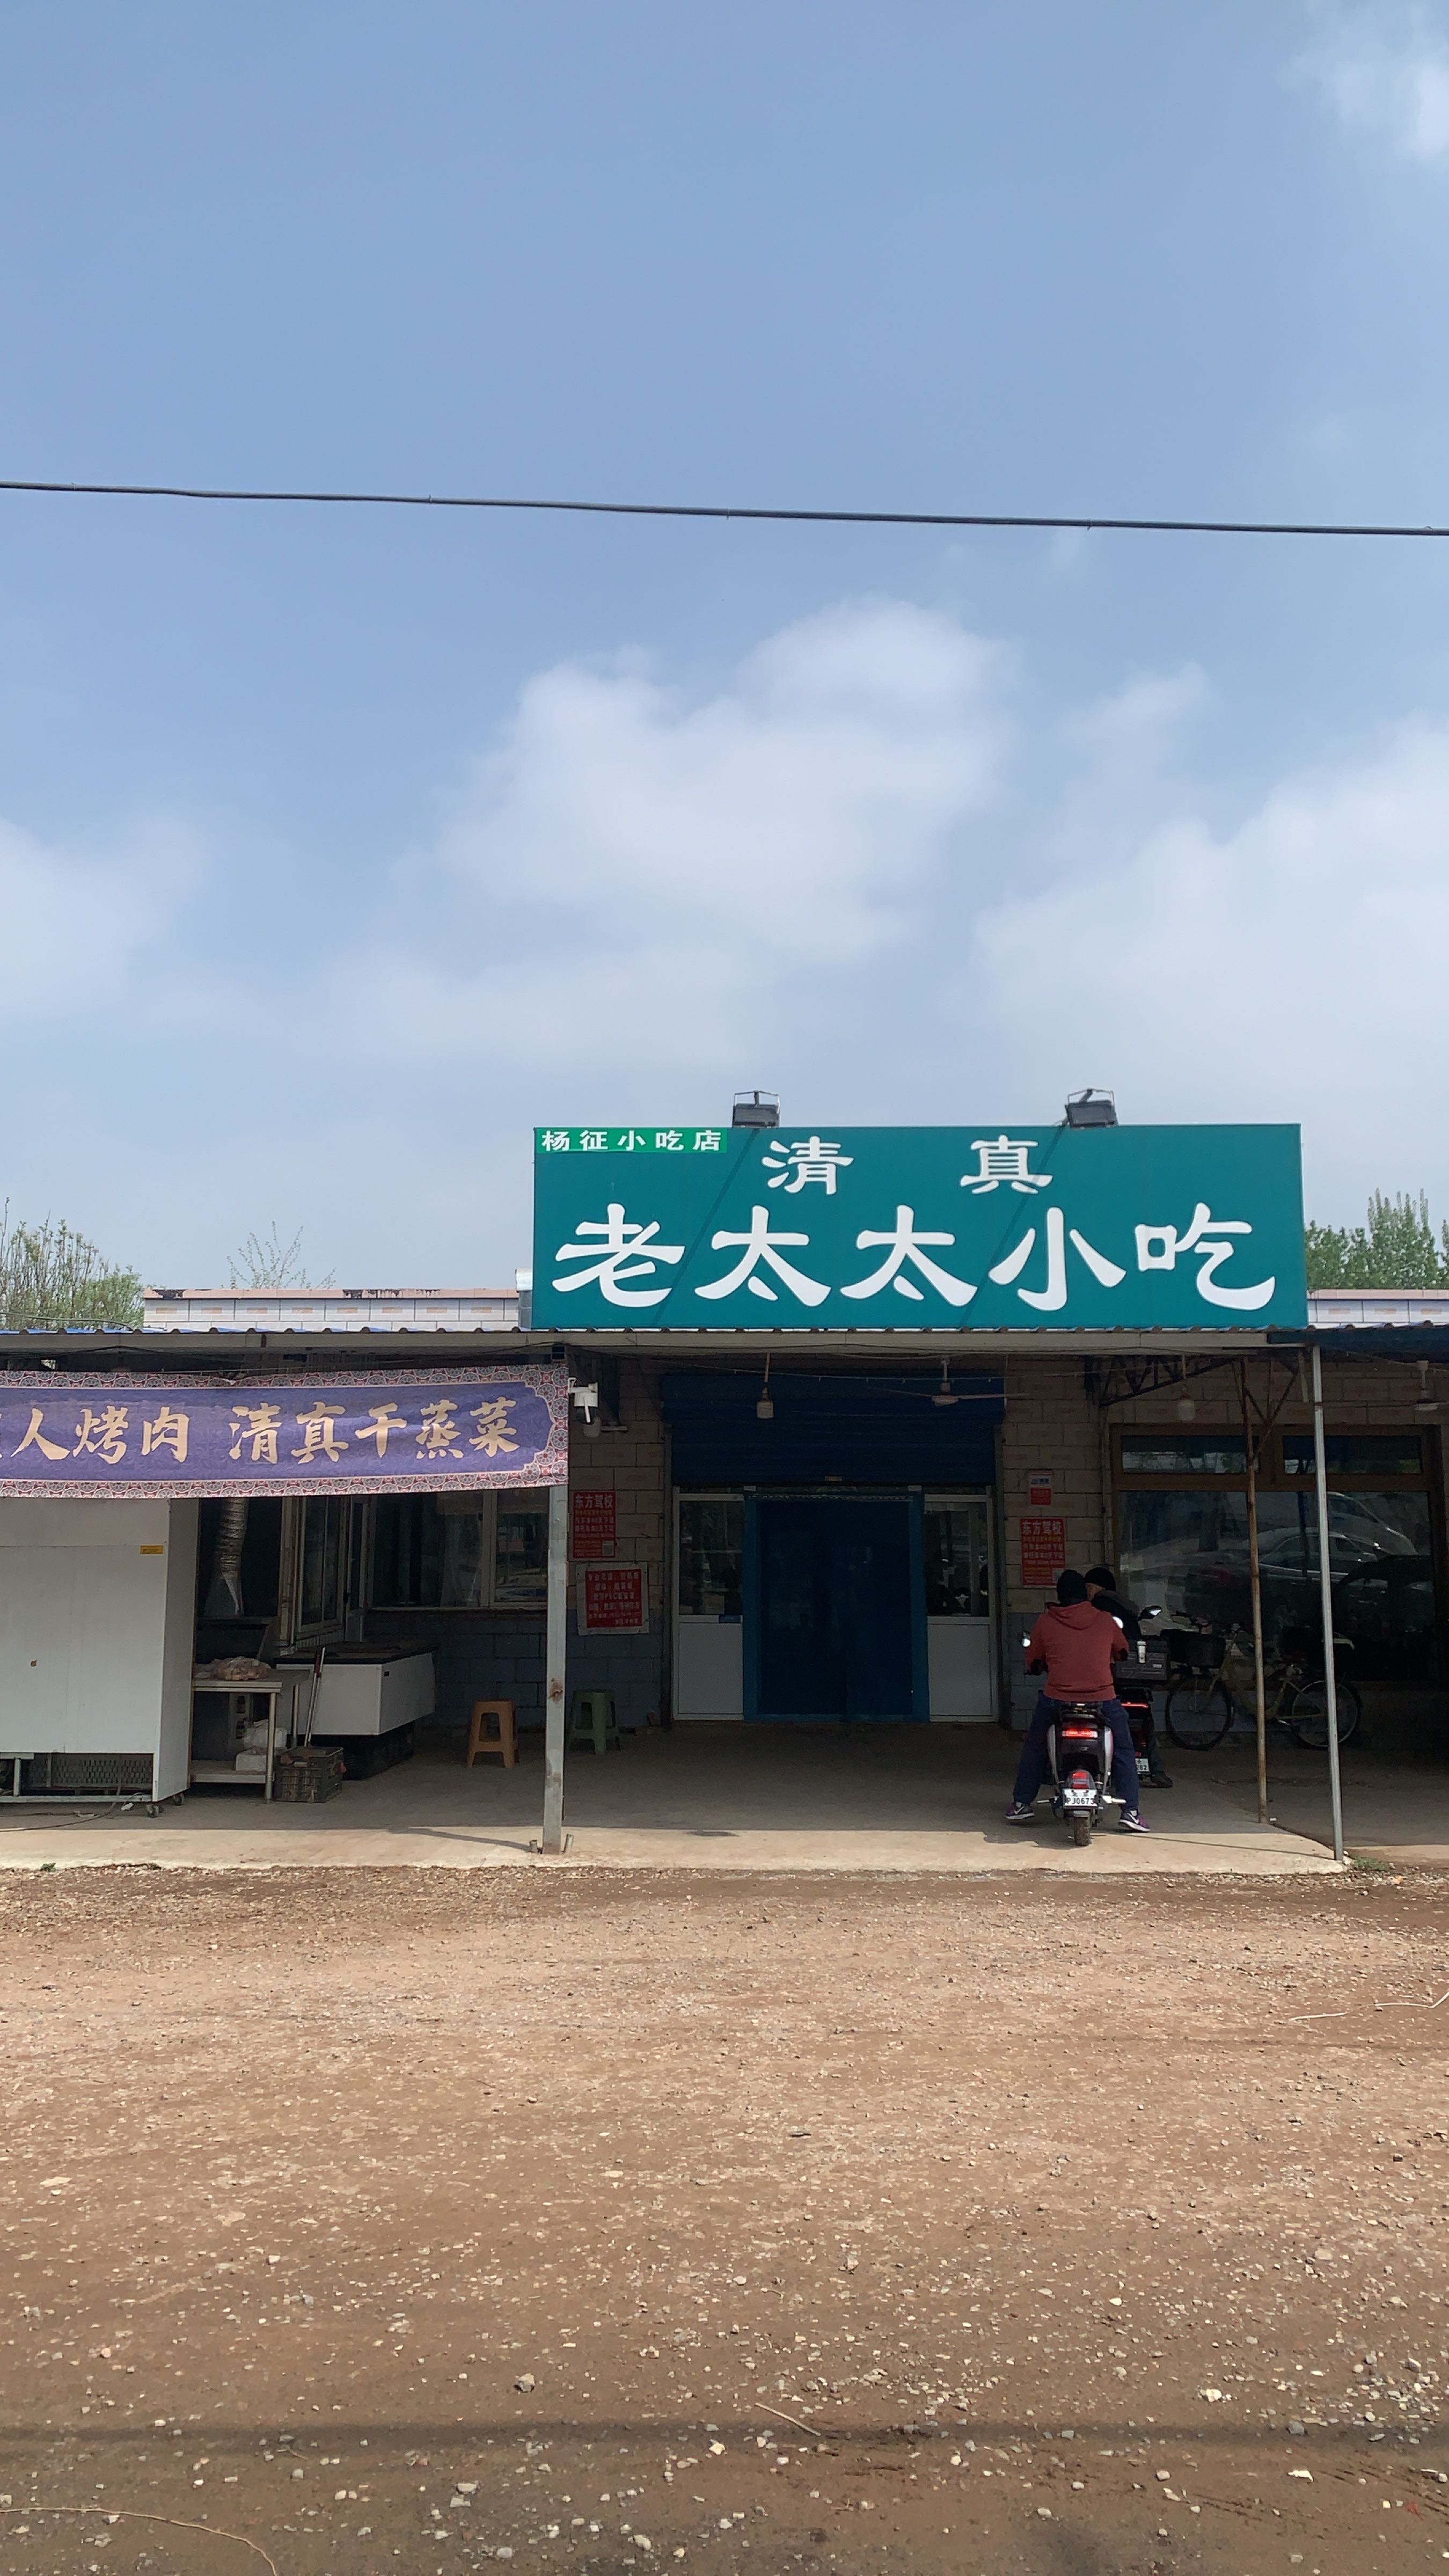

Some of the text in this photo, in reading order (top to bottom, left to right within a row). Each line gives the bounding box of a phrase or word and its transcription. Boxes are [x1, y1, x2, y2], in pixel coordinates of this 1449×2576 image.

[542, 1130, 721, 1151] 杨征小吃店
[762, 1135, 1053, 1195] 清真
[552, 1202, 1276, 1311] 老太太小吃
[0, 1406, 189, 1465] 人烤肉
[575, 1494, 613, 1509] 东方驾校
